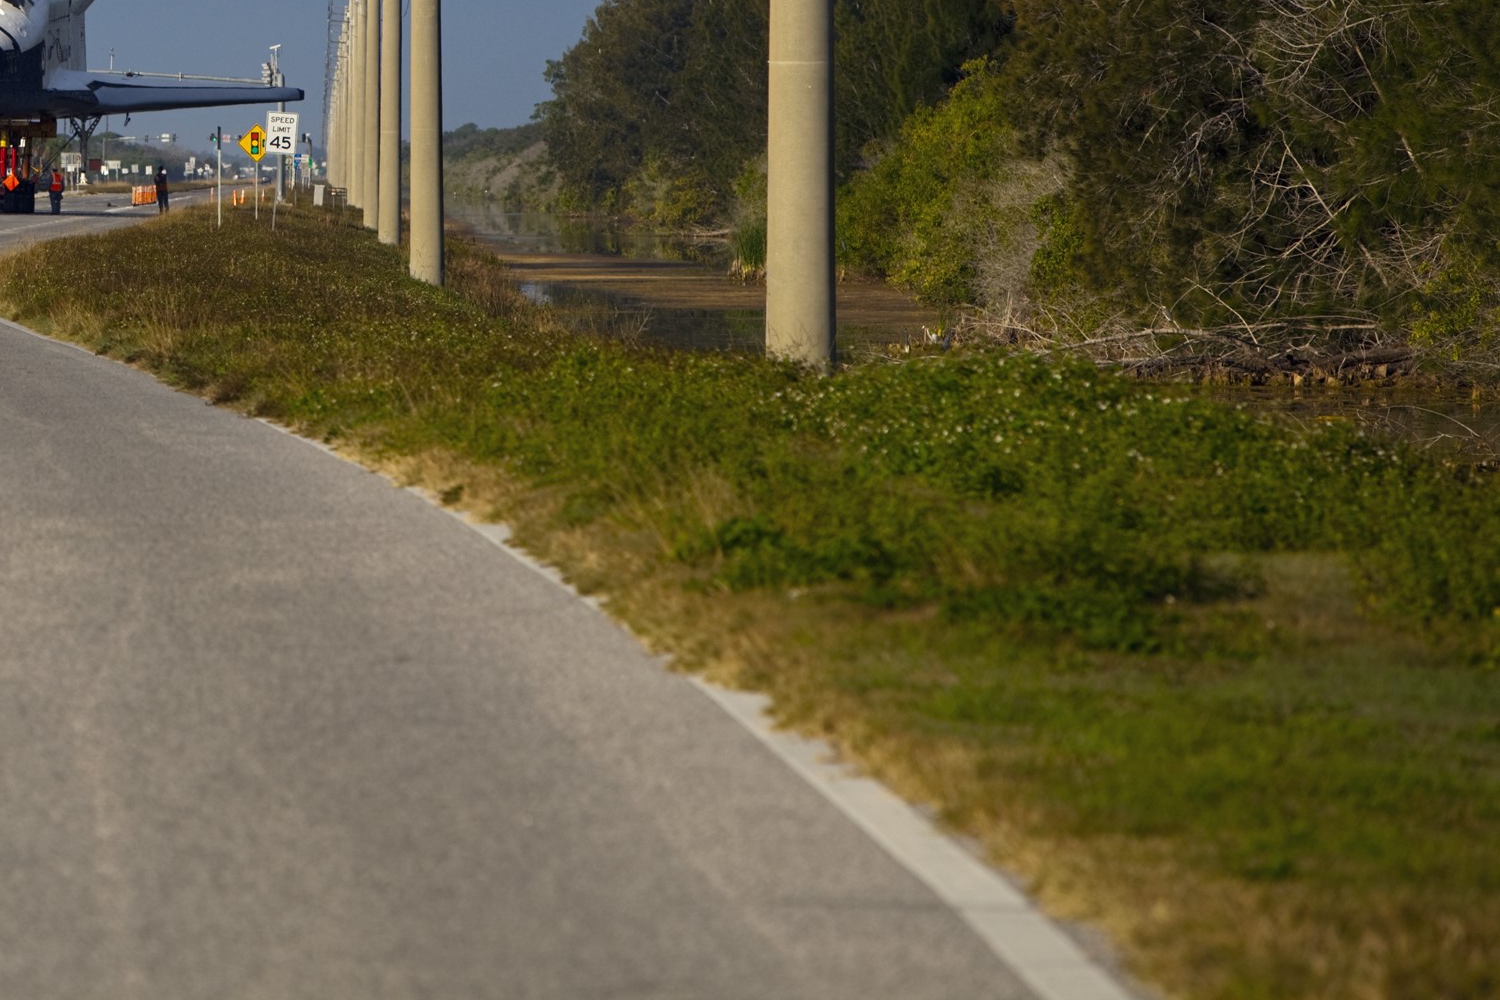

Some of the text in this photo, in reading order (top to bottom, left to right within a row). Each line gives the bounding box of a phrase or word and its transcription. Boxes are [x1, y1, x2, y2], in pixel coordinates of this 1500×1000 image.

[270, 116, 295, 125] SPEED
[272, 126, 291, 134] LIMIT
[269, 136, 291, 149] 45
